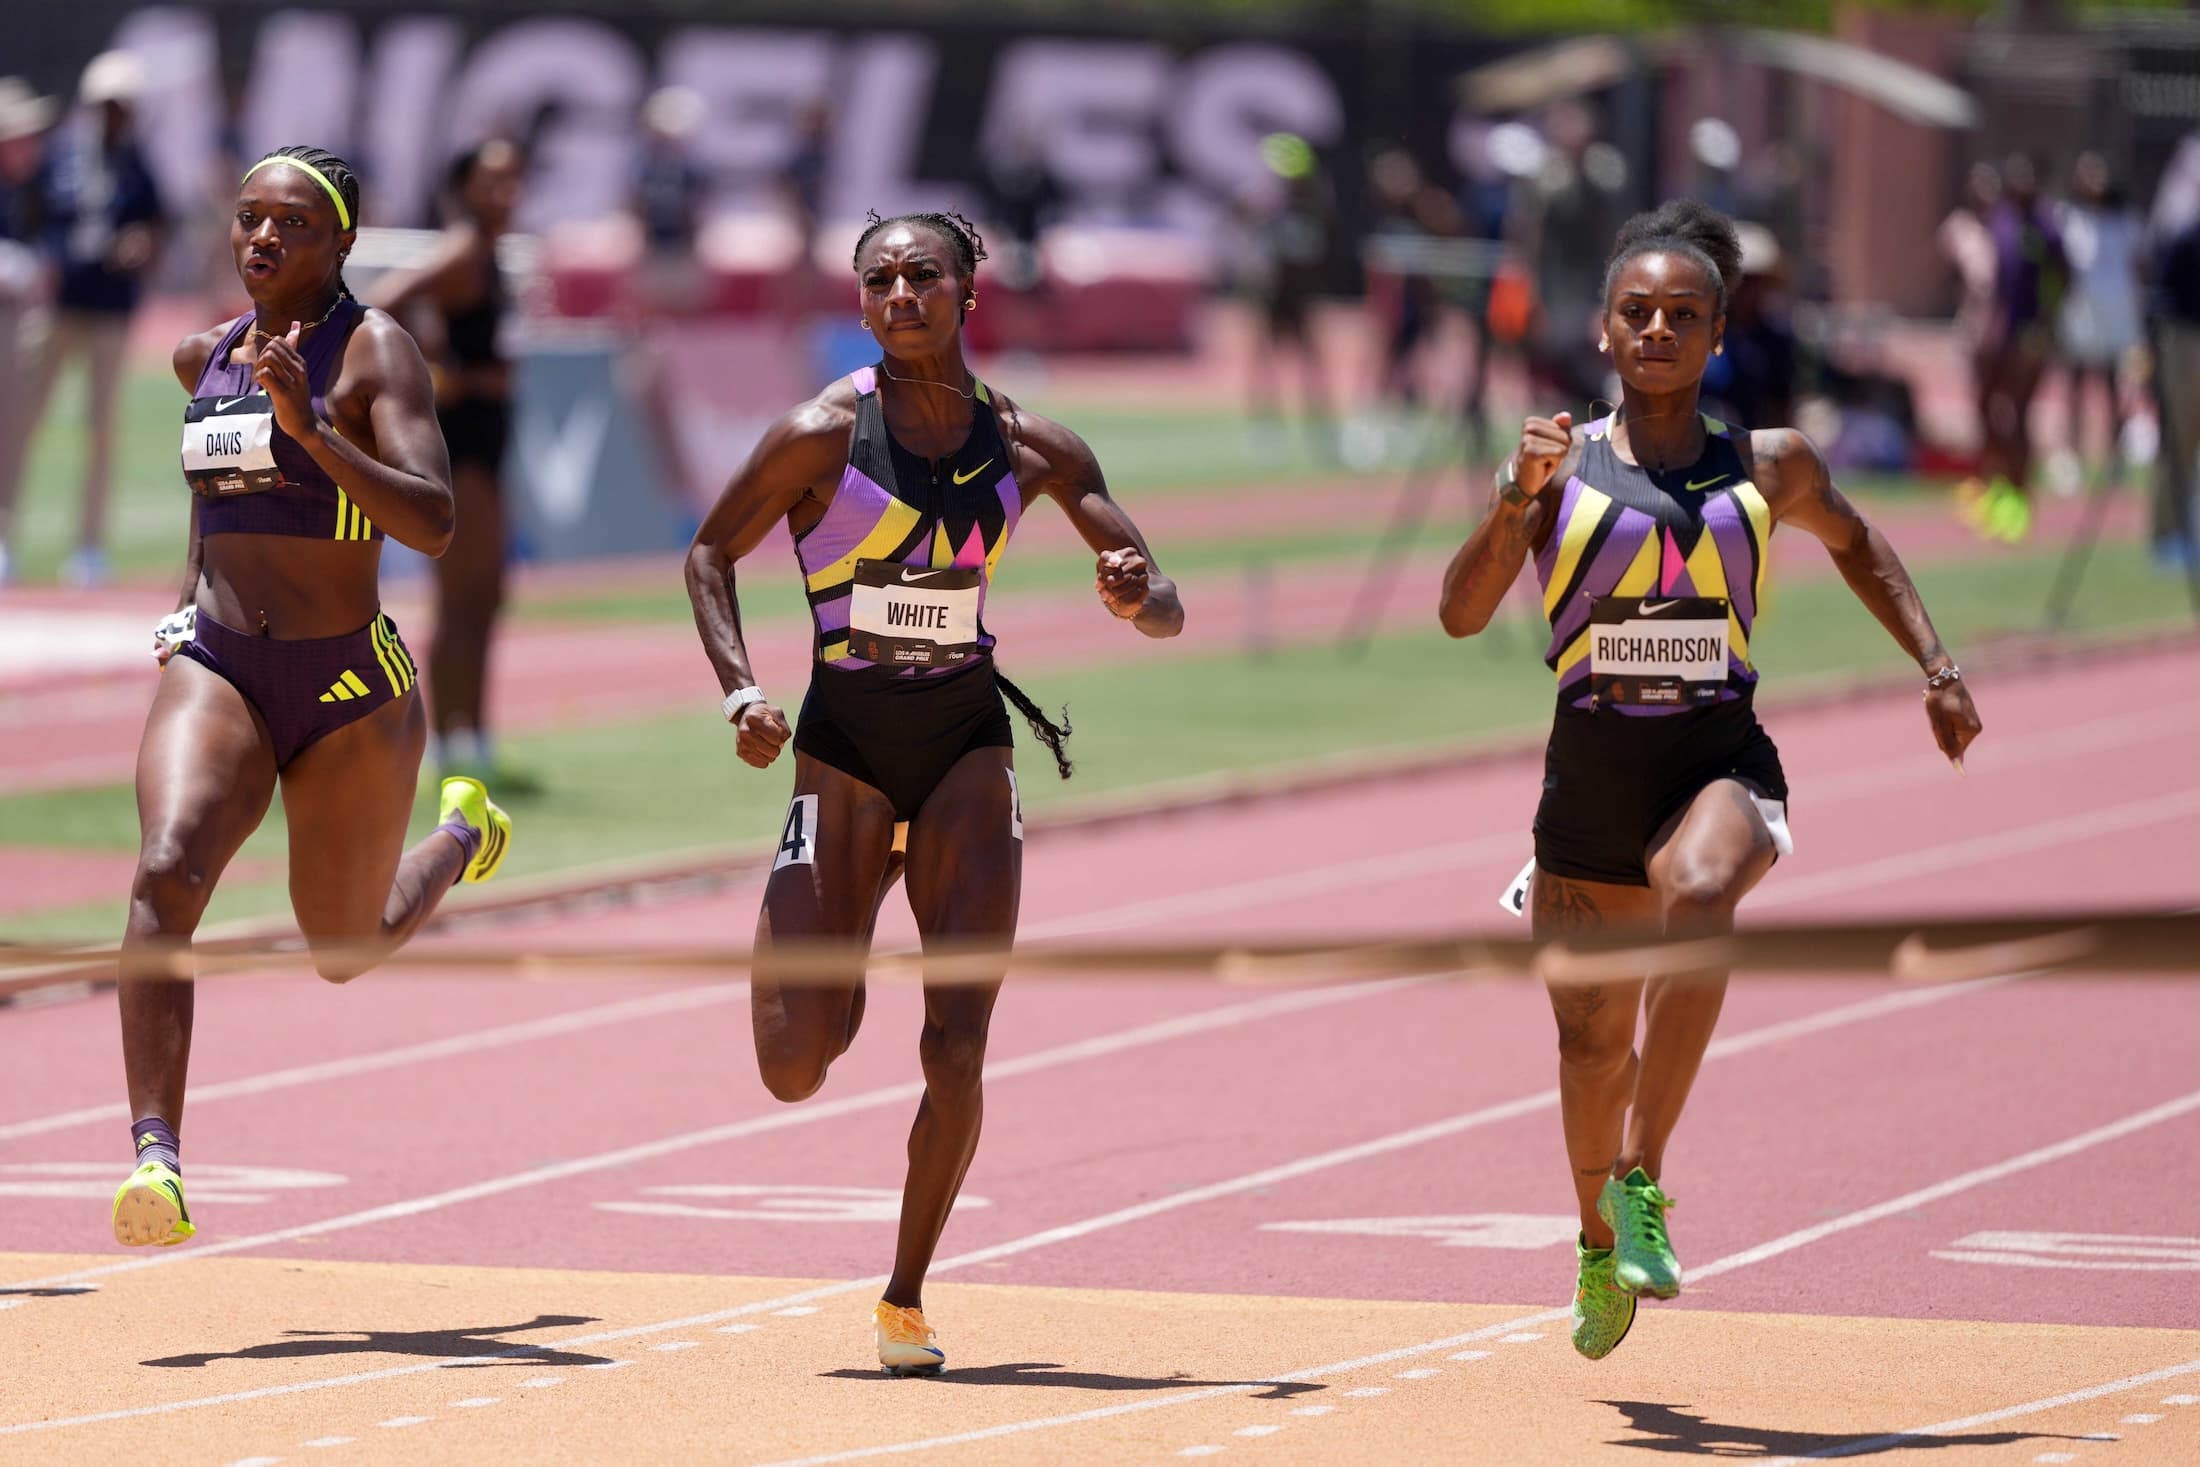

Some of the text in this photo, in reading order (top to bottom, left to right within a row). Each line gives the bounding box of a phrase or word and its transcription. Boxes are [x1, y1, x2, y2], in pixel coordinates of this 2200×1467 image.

[206, 431, 242, 456] DAVIS
[888, 601, 948, 629] WHITE
[1598, 637, 1721, 662] RICHARDSON
[781, 800, 806, 860] 4
